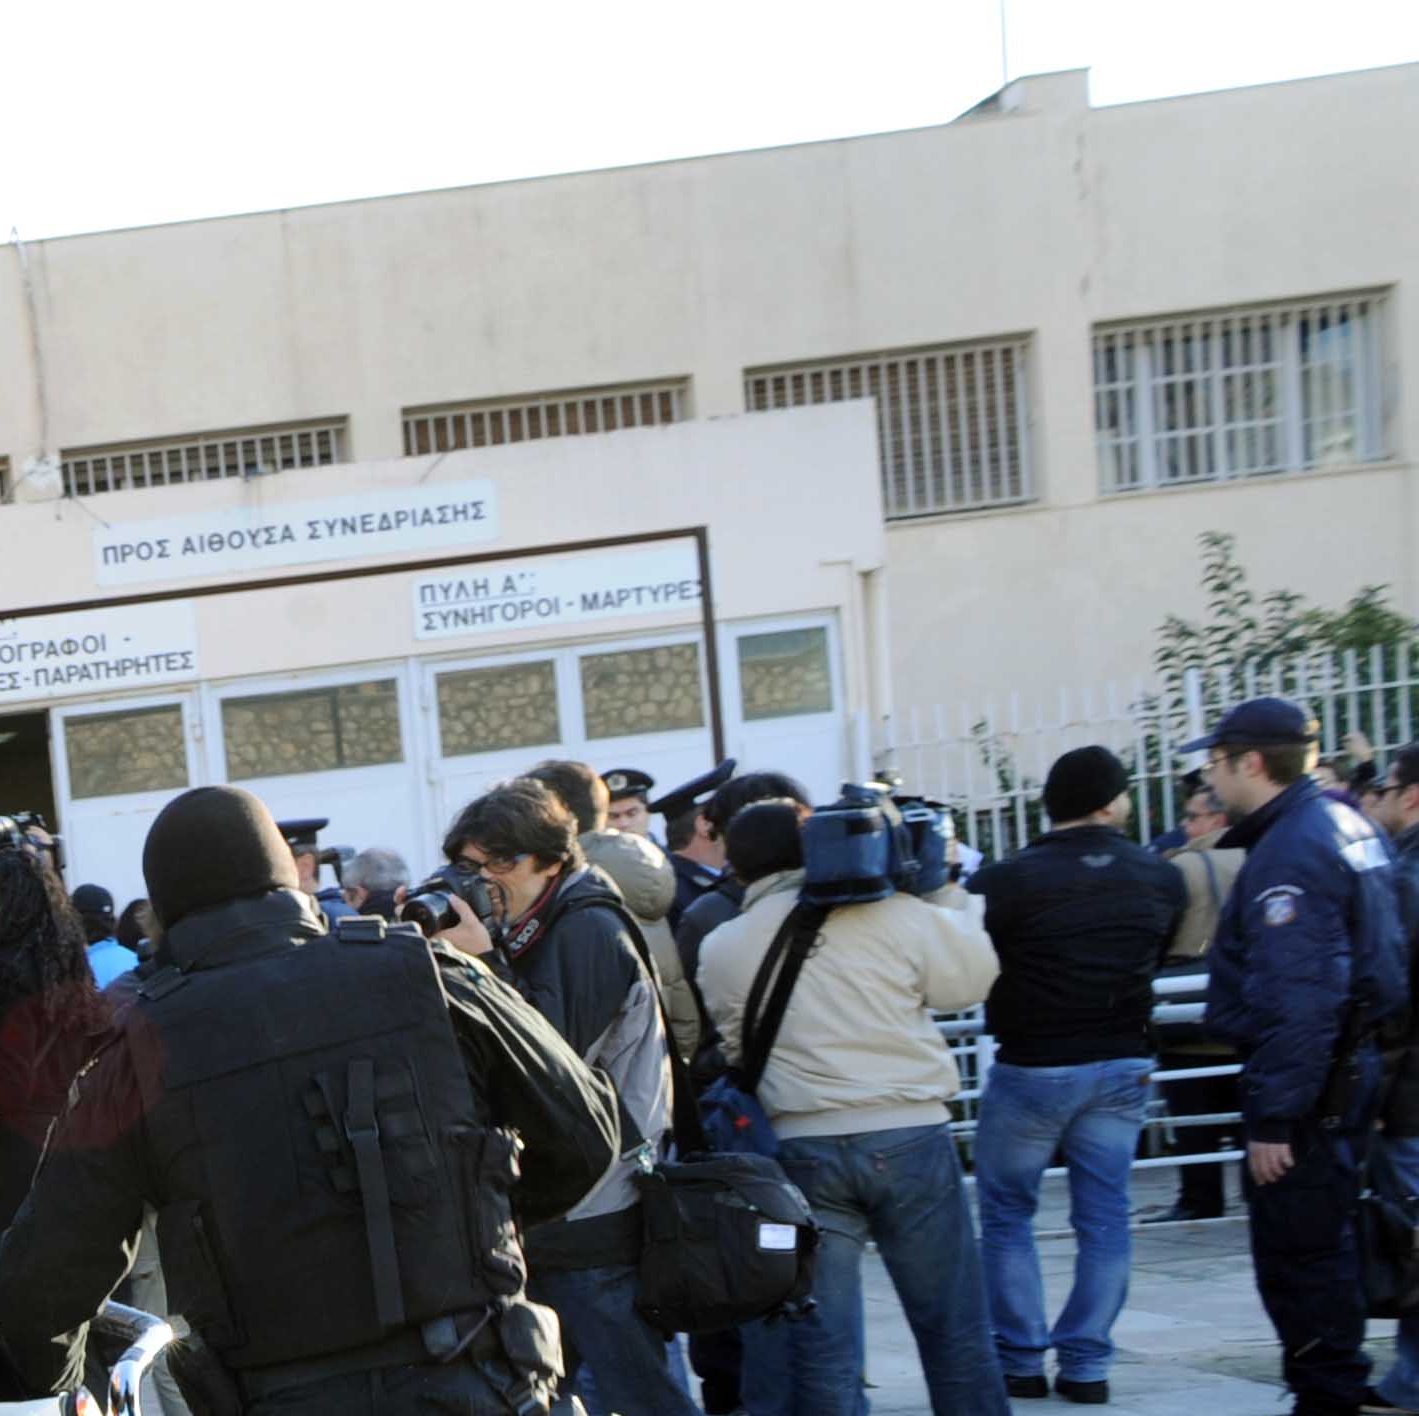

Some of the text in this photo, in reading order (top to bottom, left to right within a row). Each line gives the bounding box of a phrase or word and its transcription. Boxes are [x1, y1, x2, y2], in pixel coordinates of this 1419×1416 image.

[101, 499, 486, 566] ΠΡΟΣ ΑΙΘΟΥΣΑ ΣΥΝΕΔΡΙΑΣΗΣ
[419, 577, 489, 604] ΠΥΛΗ
[422, 596, 561, 632] ΣΥΝΗΓΟΡΟΙ
